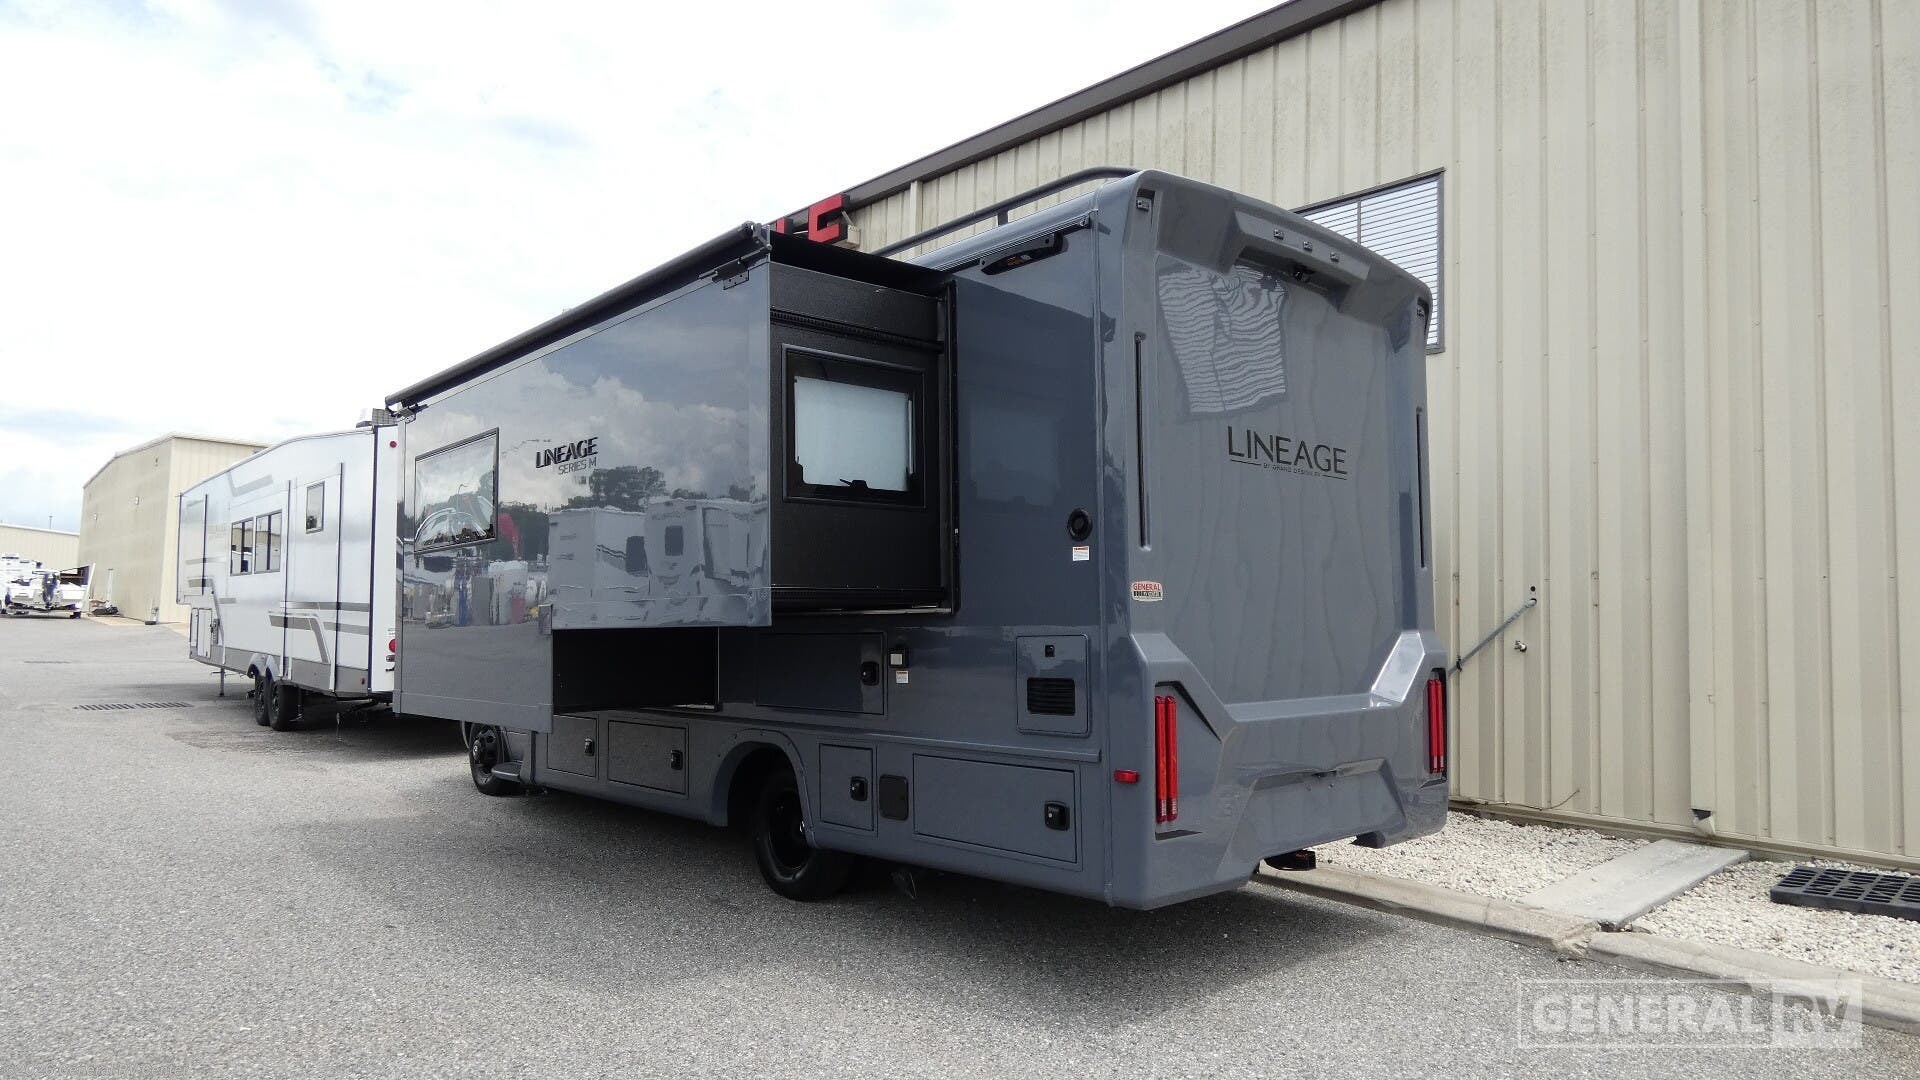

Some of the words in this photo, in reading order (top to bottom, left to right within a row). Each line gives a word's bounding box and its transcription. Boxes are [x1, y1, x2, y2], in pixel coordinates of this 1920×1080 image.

[535, 436, 599, 468] LINEAGE
[1227, 425, 1348, 475] LINEAGE
[558, 459, 587, 475] SERIES
[588, 456, 597, 469] M
[1132, 583, 1161, 591] GENERAL
